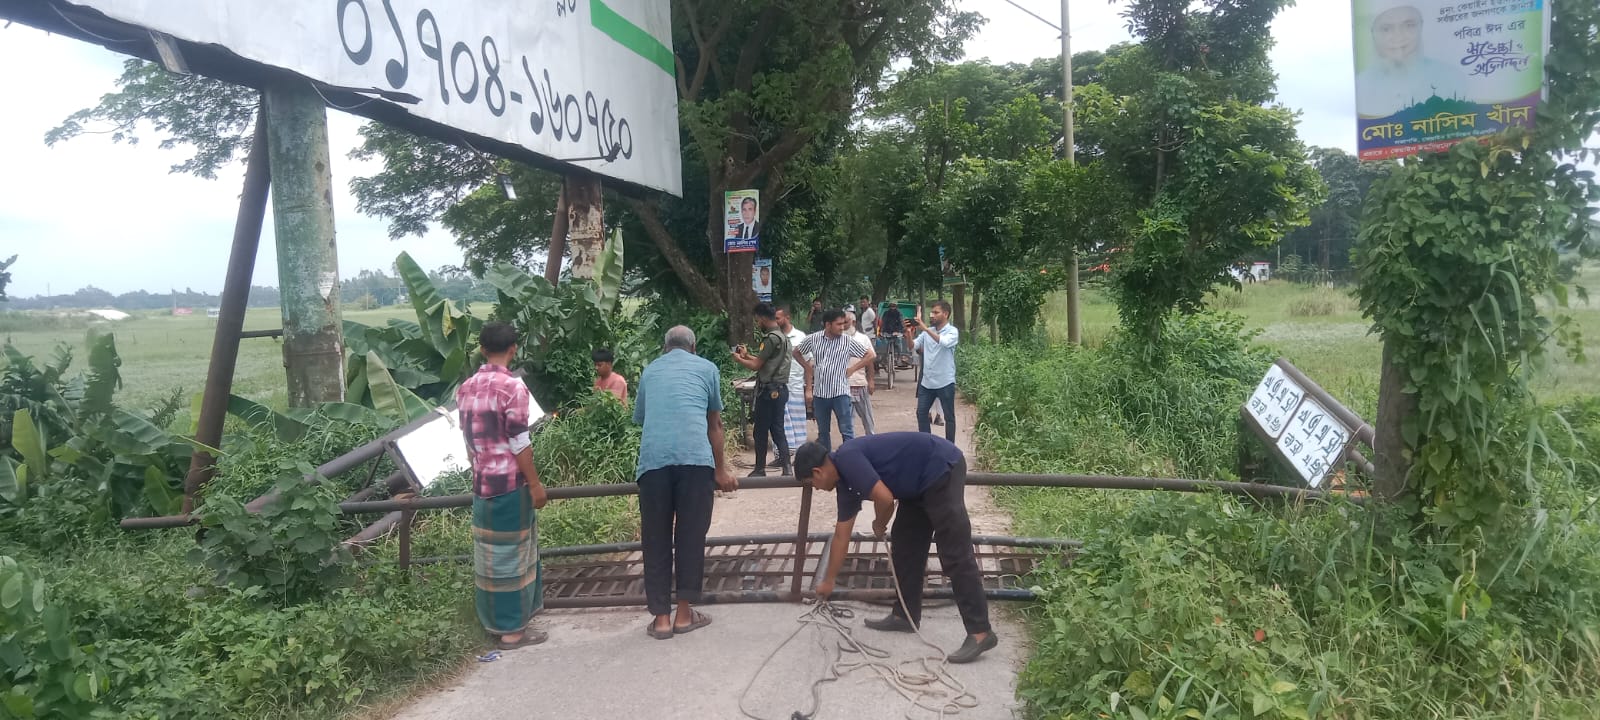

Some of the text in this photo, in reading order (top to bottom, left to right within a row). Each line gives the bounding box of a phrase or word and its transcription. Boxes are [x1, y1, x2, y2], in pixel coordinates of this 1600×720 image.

[1454, 20, 1526, 40] পবিত্র ঈদ এর
[1362, 104, 1531, 141] মোঃ নাসিম খাঁন
